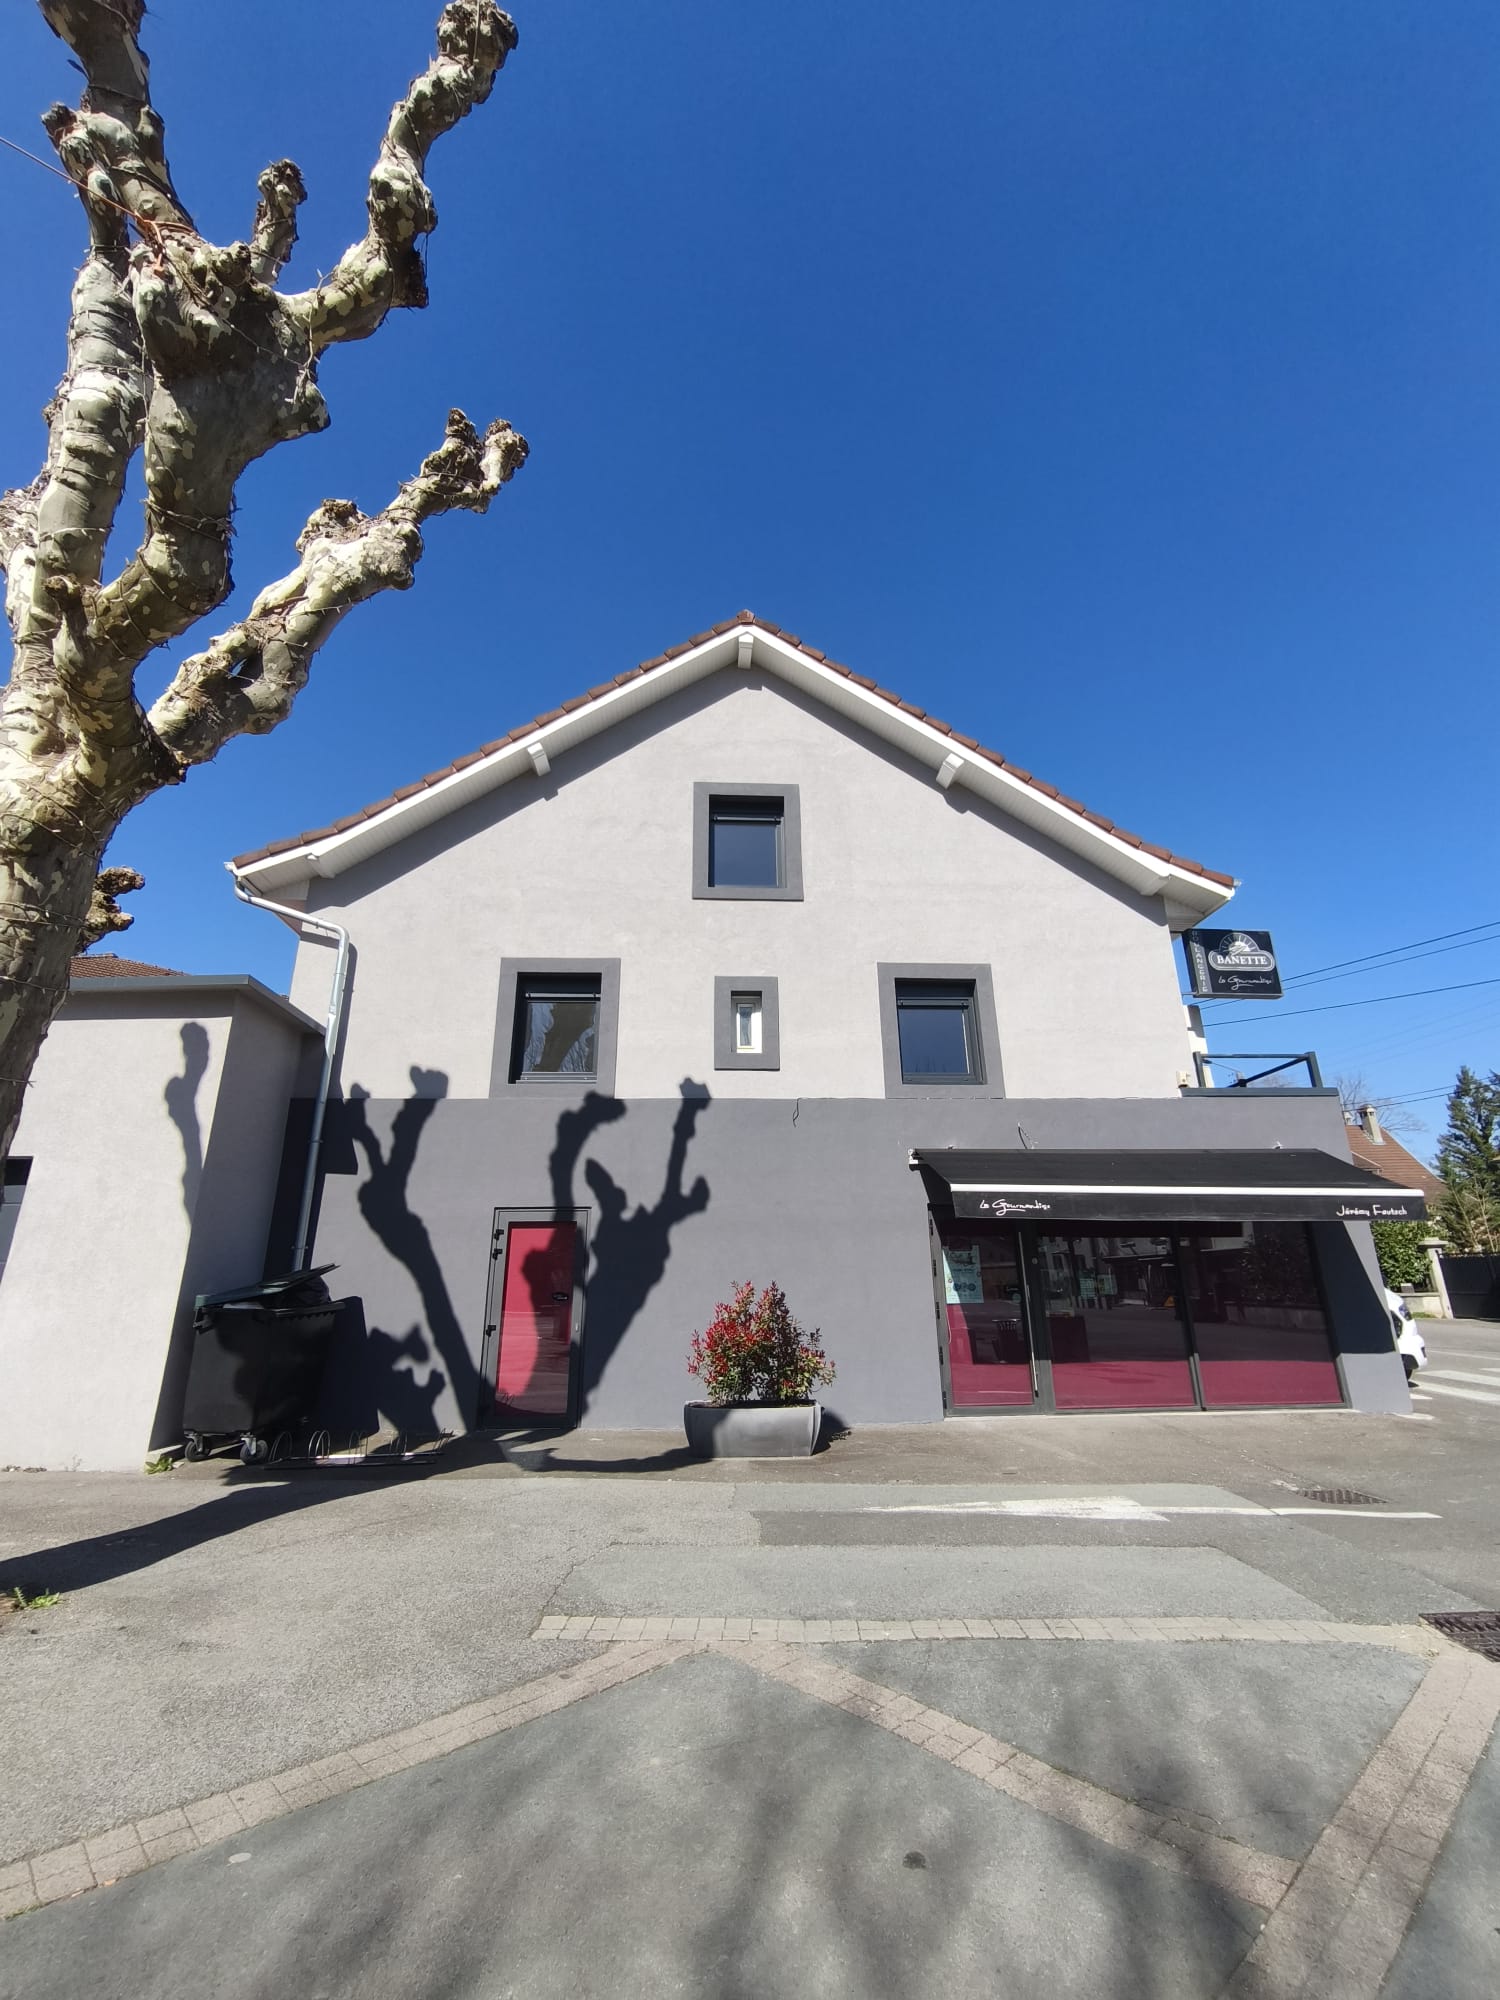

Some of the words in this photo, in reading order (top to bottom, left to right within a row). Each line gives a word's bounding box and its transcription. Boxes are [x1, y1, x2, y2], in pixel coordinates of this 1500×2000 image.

[1216, 954, 1268, 966] BANETTE
[980, 1199, 990, 1209] La
[991, 1198, 1051, 1216] Gourmandise
